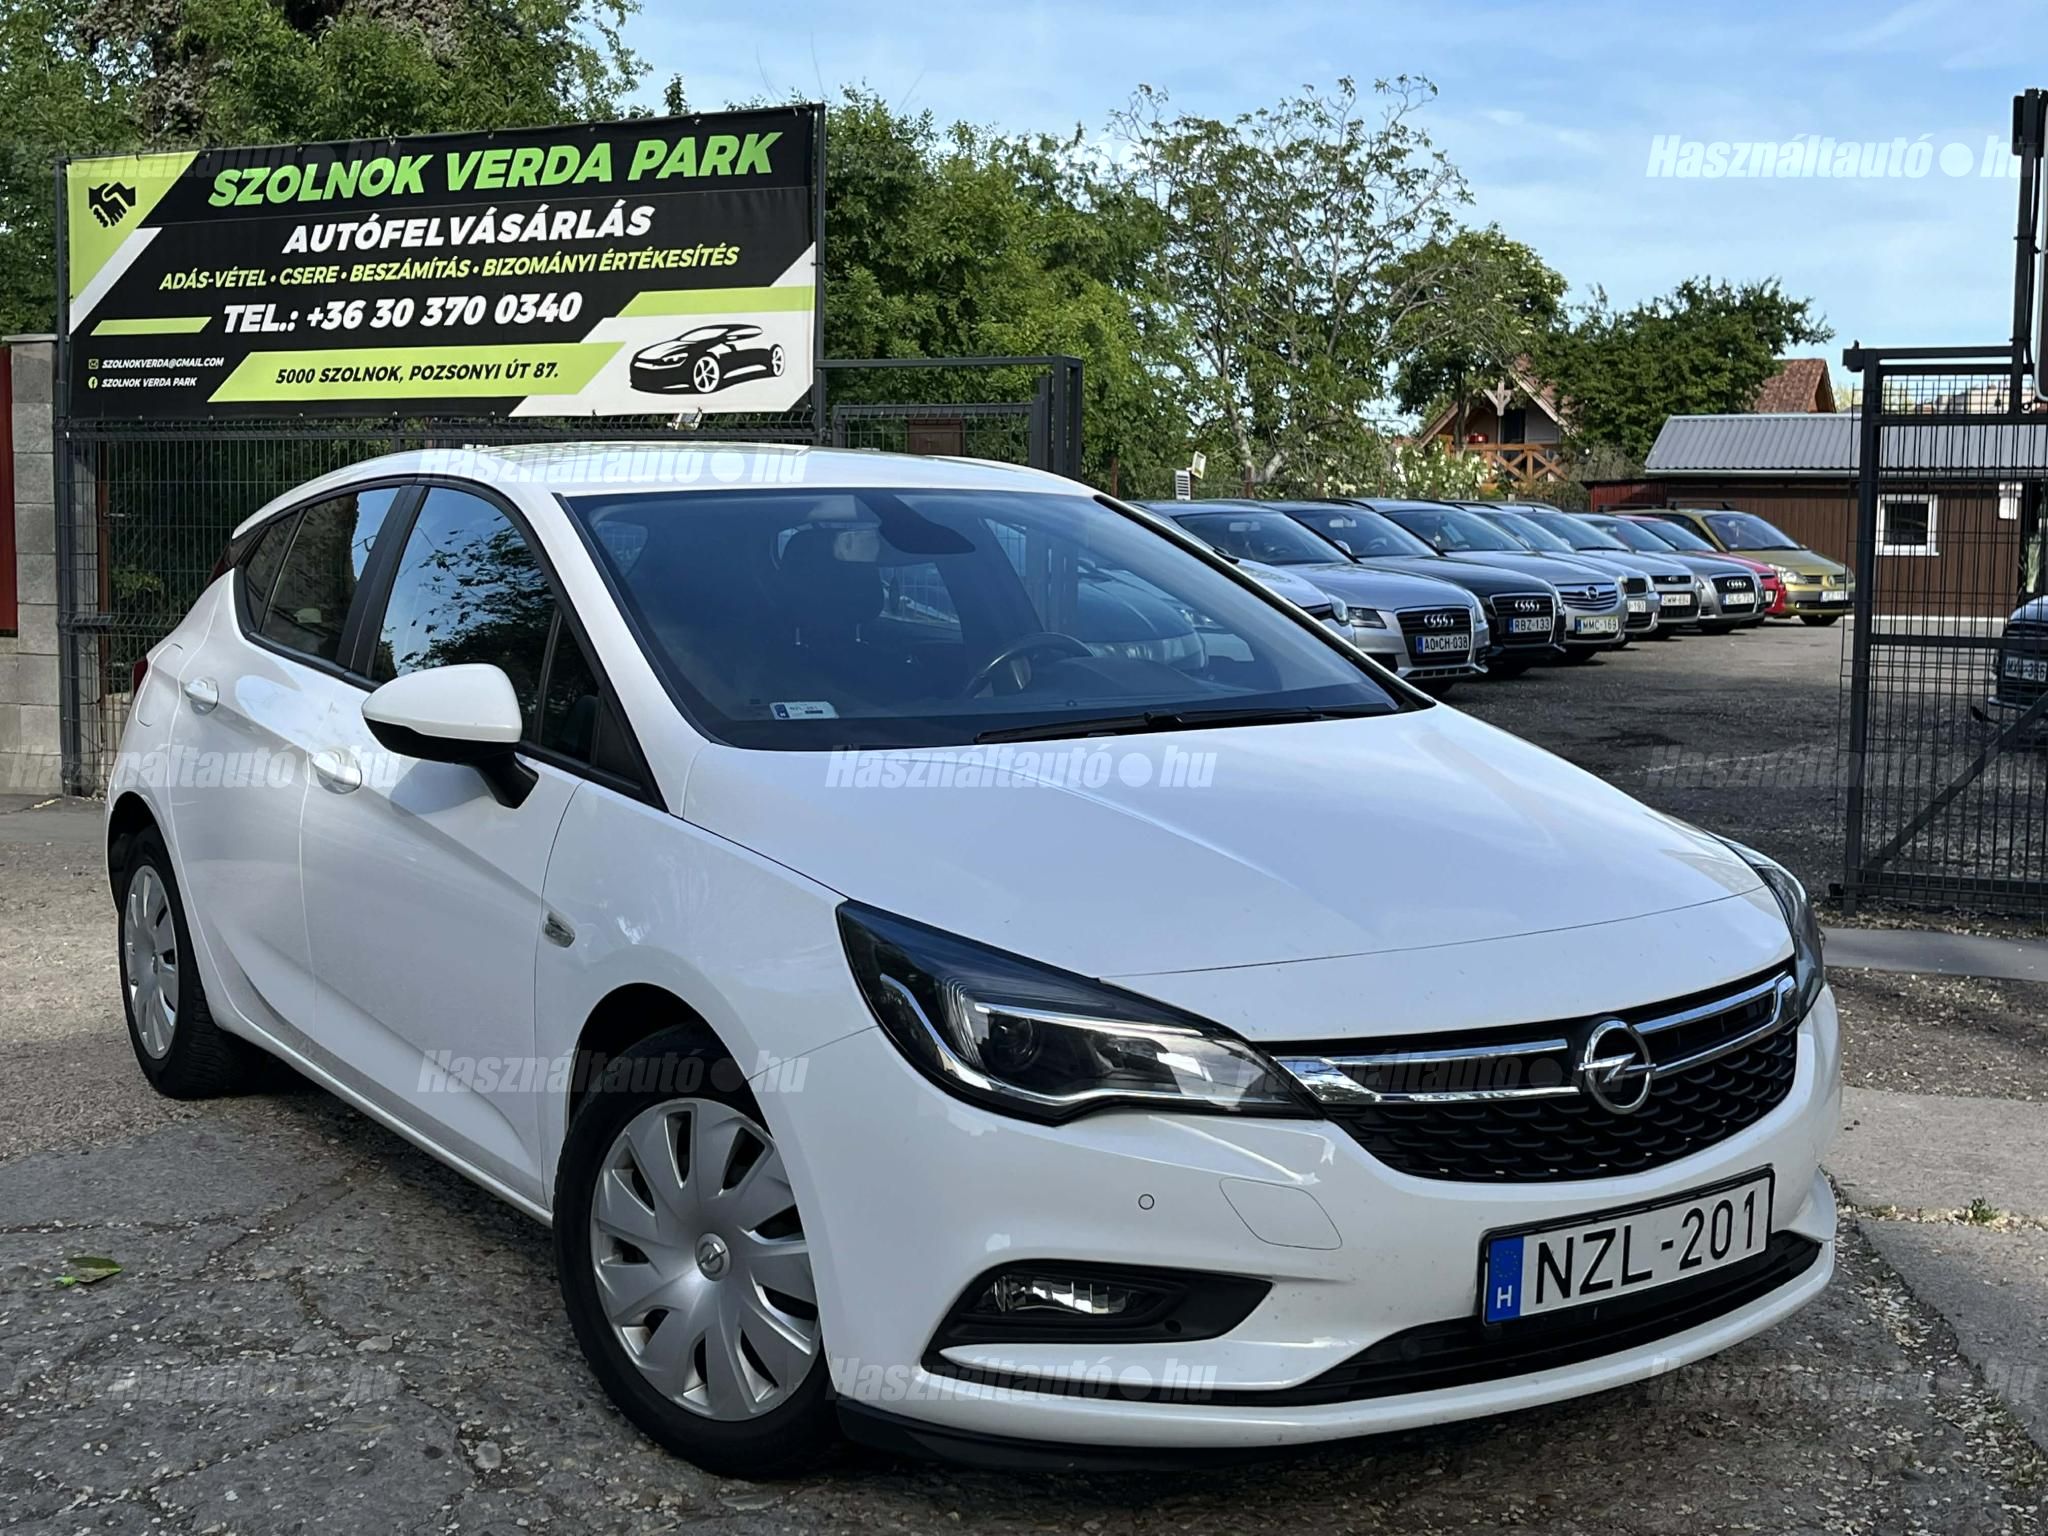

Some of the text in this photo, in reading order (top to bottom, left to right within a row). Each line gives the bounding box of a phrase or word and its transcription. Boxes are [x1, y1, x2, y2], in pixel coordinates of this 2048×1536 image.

[208, 155, 433, 207] SZOLNOK
[446, 143, 613, 192] VERDA
[627, 132, 783, 182] PARK
[159, 242, 740, 291] ADÁS-VÉTEL CSERE BESZÁMÍTÁS BIZOMÁNYI ÉRTÉKESÍTÉS
[223, 291, 583, 334] TEL.: +36 30 370 0340
[101, 357, 225, 369] SZOLNOKVERDA@GMAIL.COM
[275, 358, 560, 385] 5000 SZOLNOK, POZSONYI ÚT 87.
[101, 376, 198, 388] SZOLNOK VERDA PARK
[1514, 617, 1552, 632] RBZ-133
[1536, 1190, 1755, 1305] NZL-201
